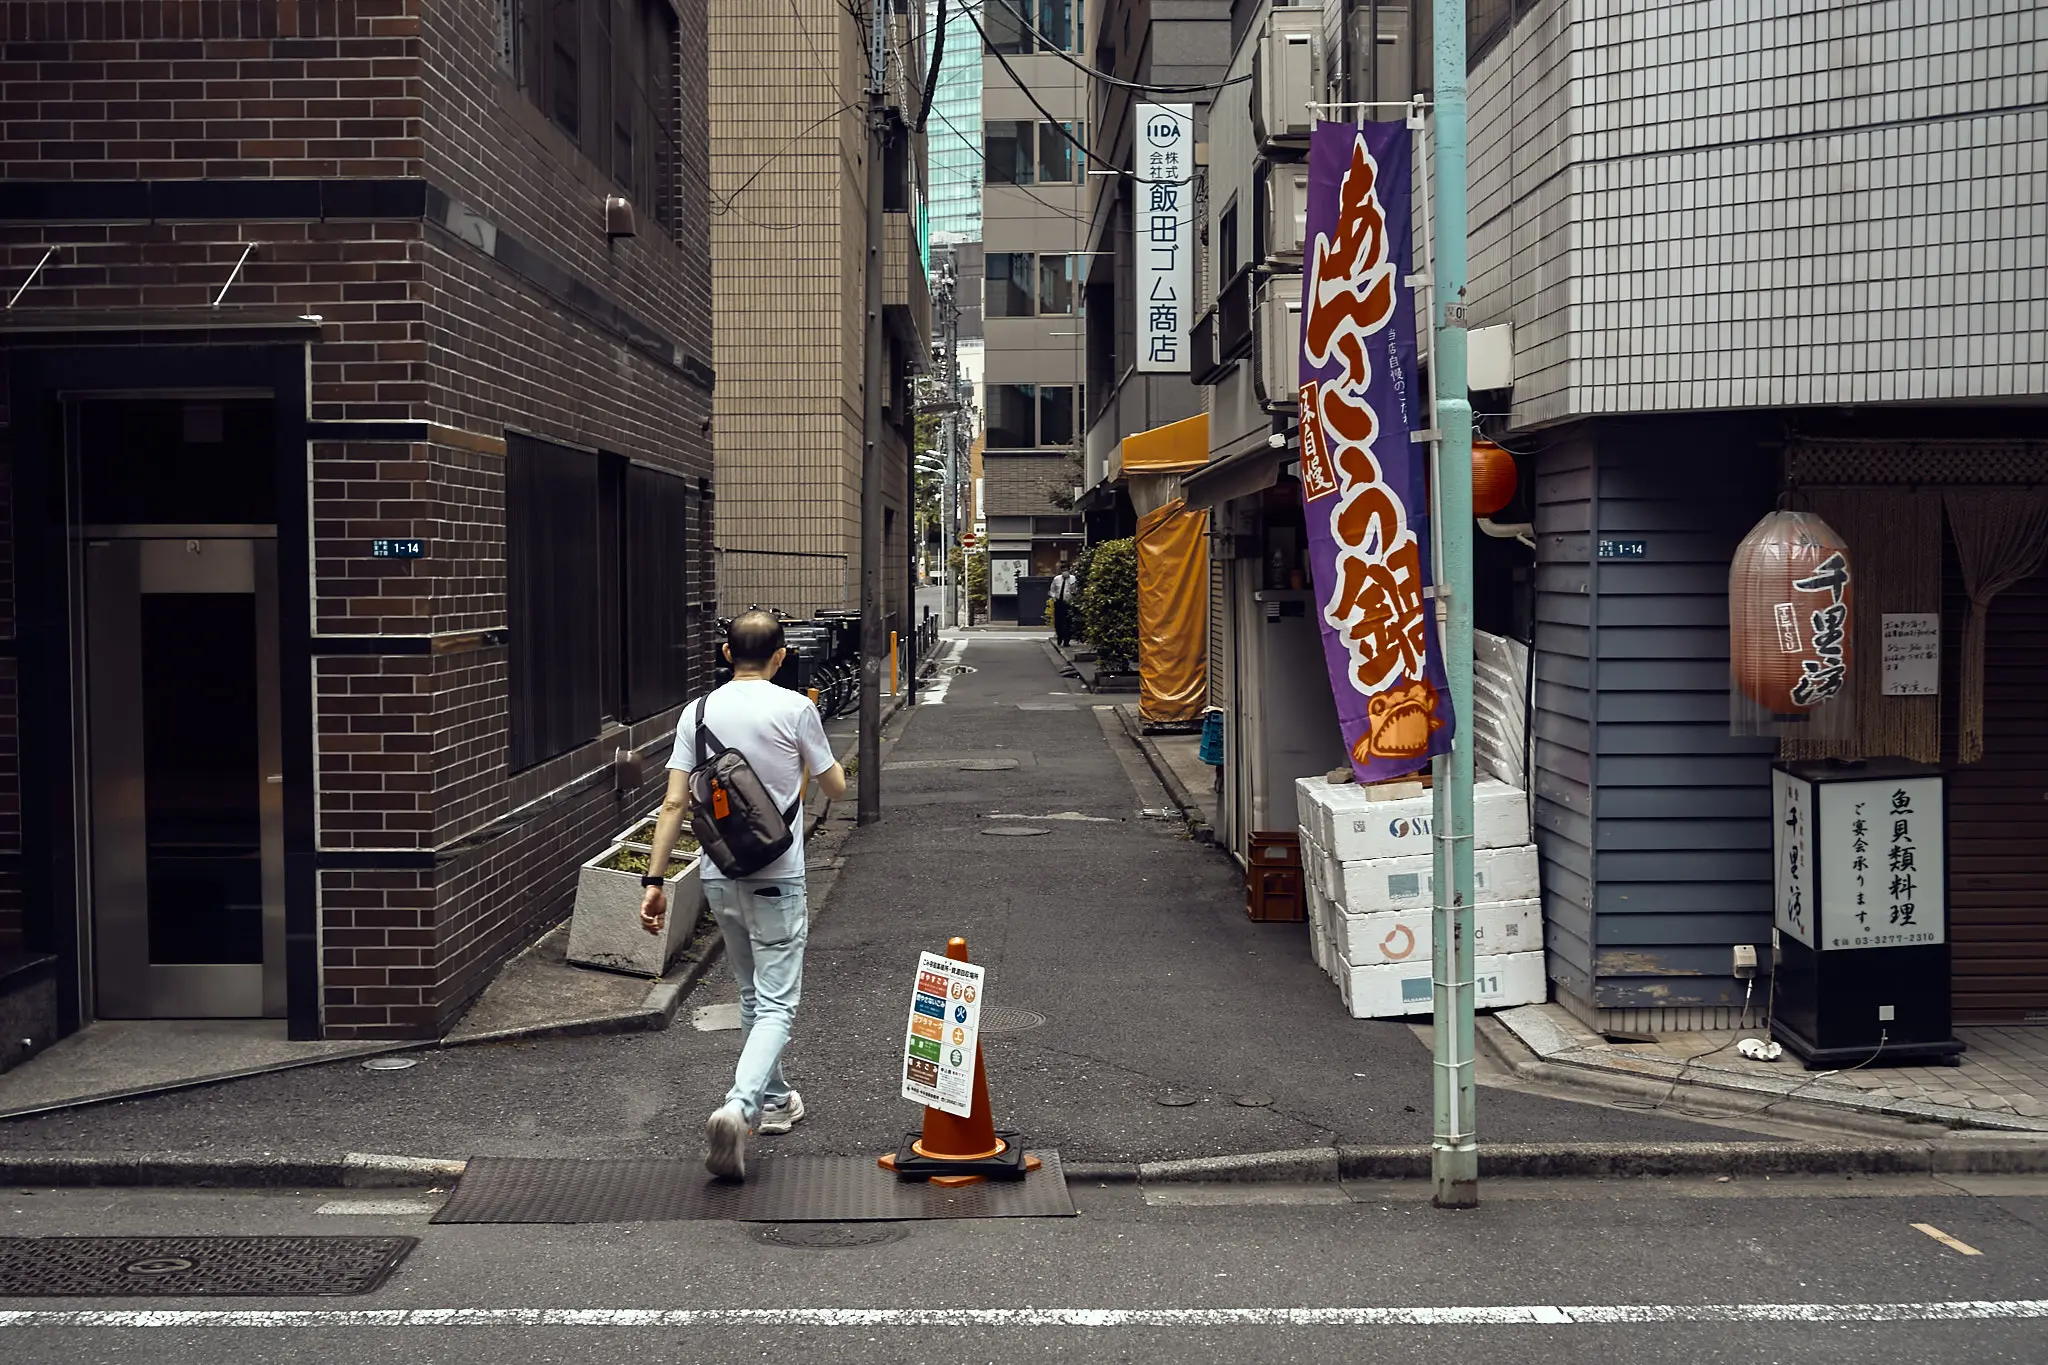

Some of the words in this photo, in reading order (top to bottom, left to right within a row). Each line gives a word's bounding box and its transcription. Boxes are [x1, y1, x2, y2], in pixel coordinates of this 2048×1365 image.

[1147, 125, 1181, 138] IIDA
[1149, 184, 1179, 362] 飯田ゴム商店
[394, 543, 419, 553] 1-14
[1618, 544, 1643, 554] 1-14
[1888, 788, 1917, 926] 魚貝類料理
[1852, 802, 1871, 932] ご宴会承ります。
[1855, 932, 1935, 946] 03-3277-2310
[964, 985, 975, 999] 木
[956, 1006, 965, 1019] 火
[954, 1029, 962, 1041] 土
